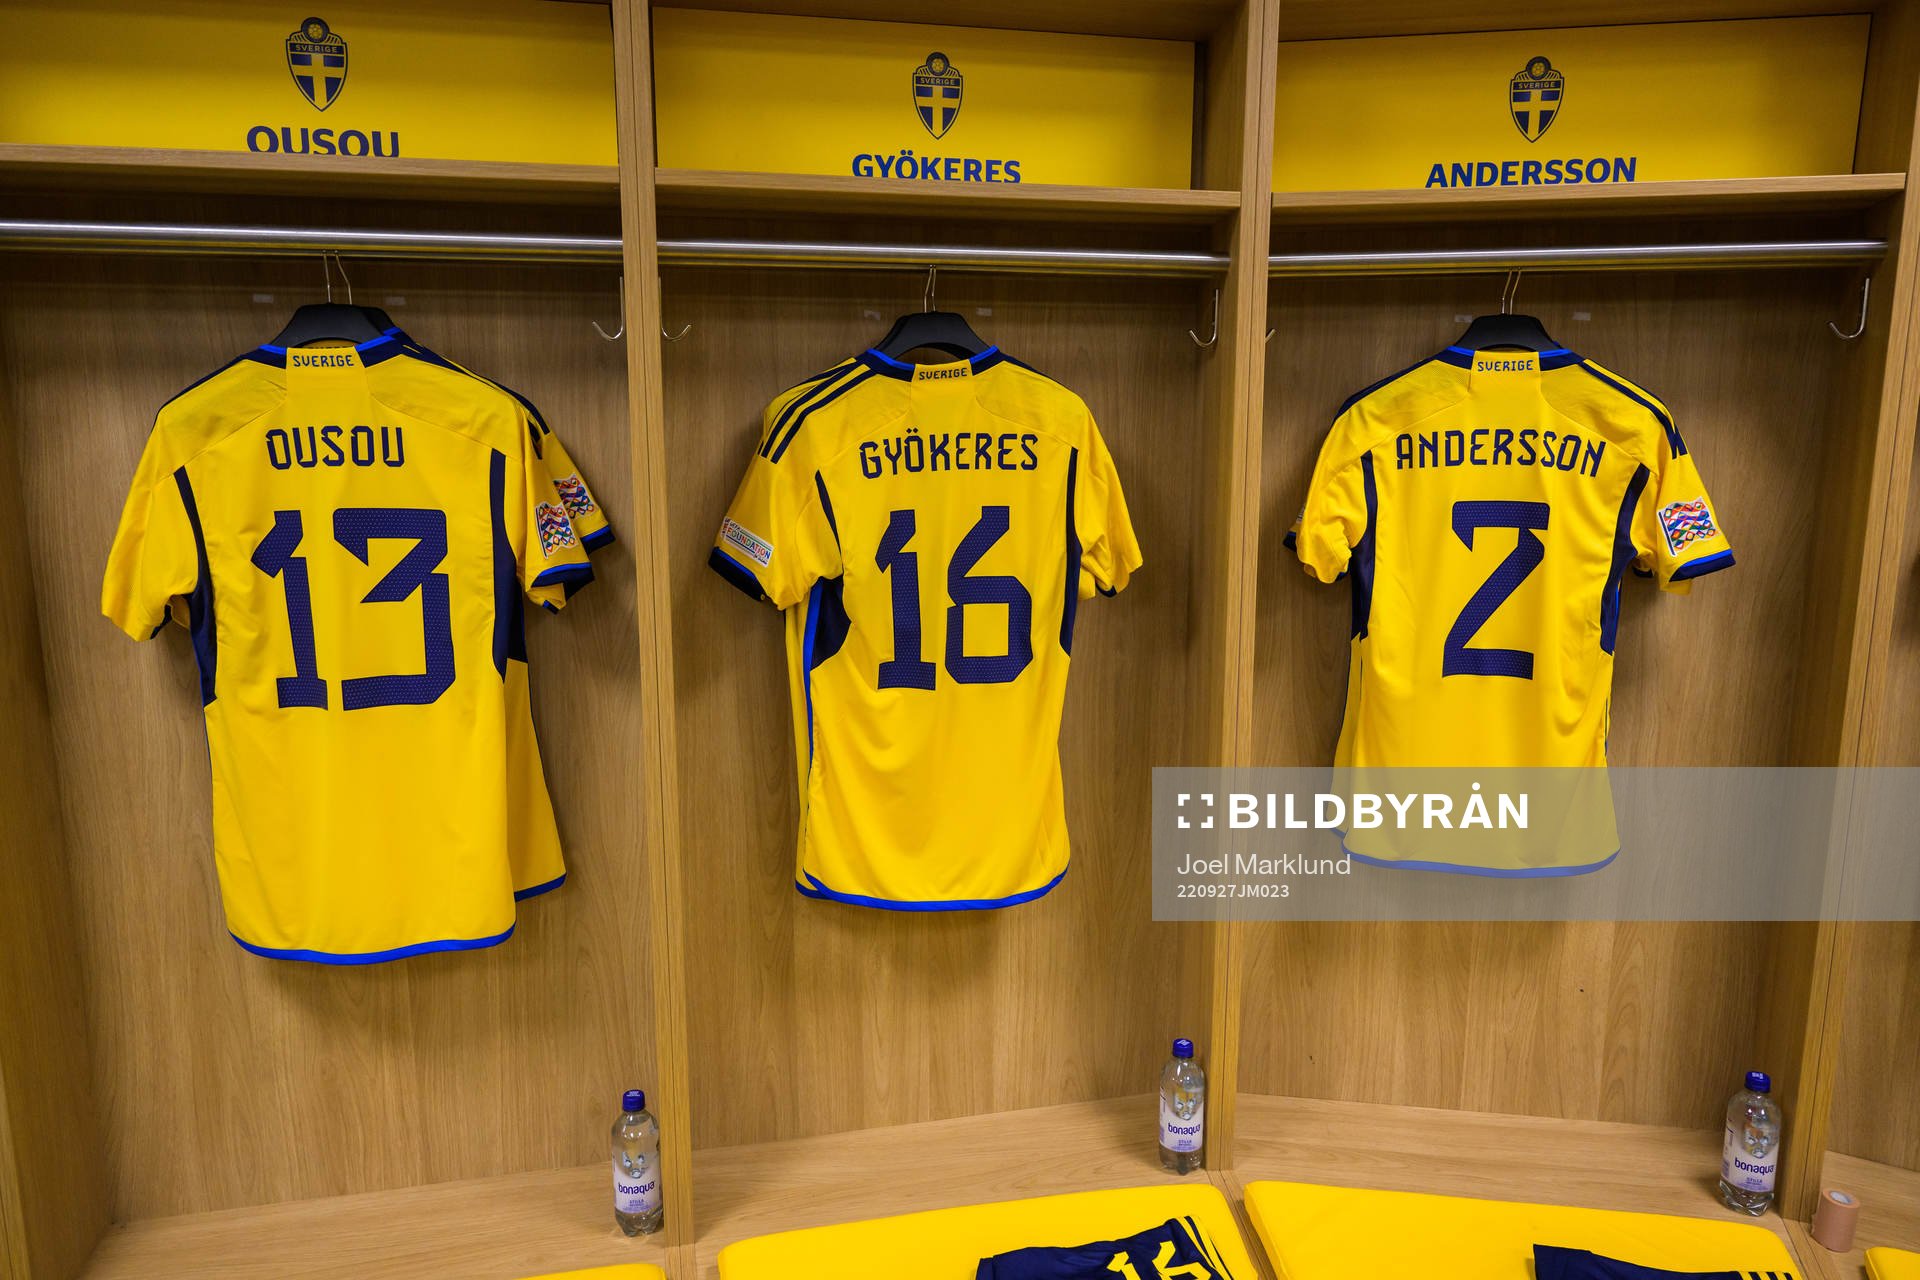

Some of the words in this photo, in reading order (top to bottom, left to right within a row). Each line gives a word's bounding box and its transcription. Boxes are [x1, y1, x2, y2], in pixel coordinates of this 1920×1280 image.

[295, 44, 338, 53] SVERIGE
[920, 77, 956, 86] SVERIGE
[1518, 81, 1556, 90] SVERIGE
[247, 125, 400, 158] OUSOU
[852, 149, 1021, 184] GYÖKERES
[1425, 156, 1637, 189] ANDERSSON
[292, 354, 355, 367] SVERIGE
[919, 367, 968, 381] SVERIGE
[1477, 360, 1534, 372] SVERIGE
[265, 425, 405, 470] OUSOU
[859, 427, 1039, 480] GYÖKERES
[1396, 428, 1607, 478] ANDERSSON
[726, 527, 771, 559] FOUNDATION
[875, 505, 1034, 691] 16
[1442, 500, 1551, 680] 2
[251, 508, 456, 711] 13
[1168, 1122, 1201, 1136] bonaqua
[1734, 1157, 1774, 1176] bonaqua
[618, 1181, 655, 1195] bonaqua
